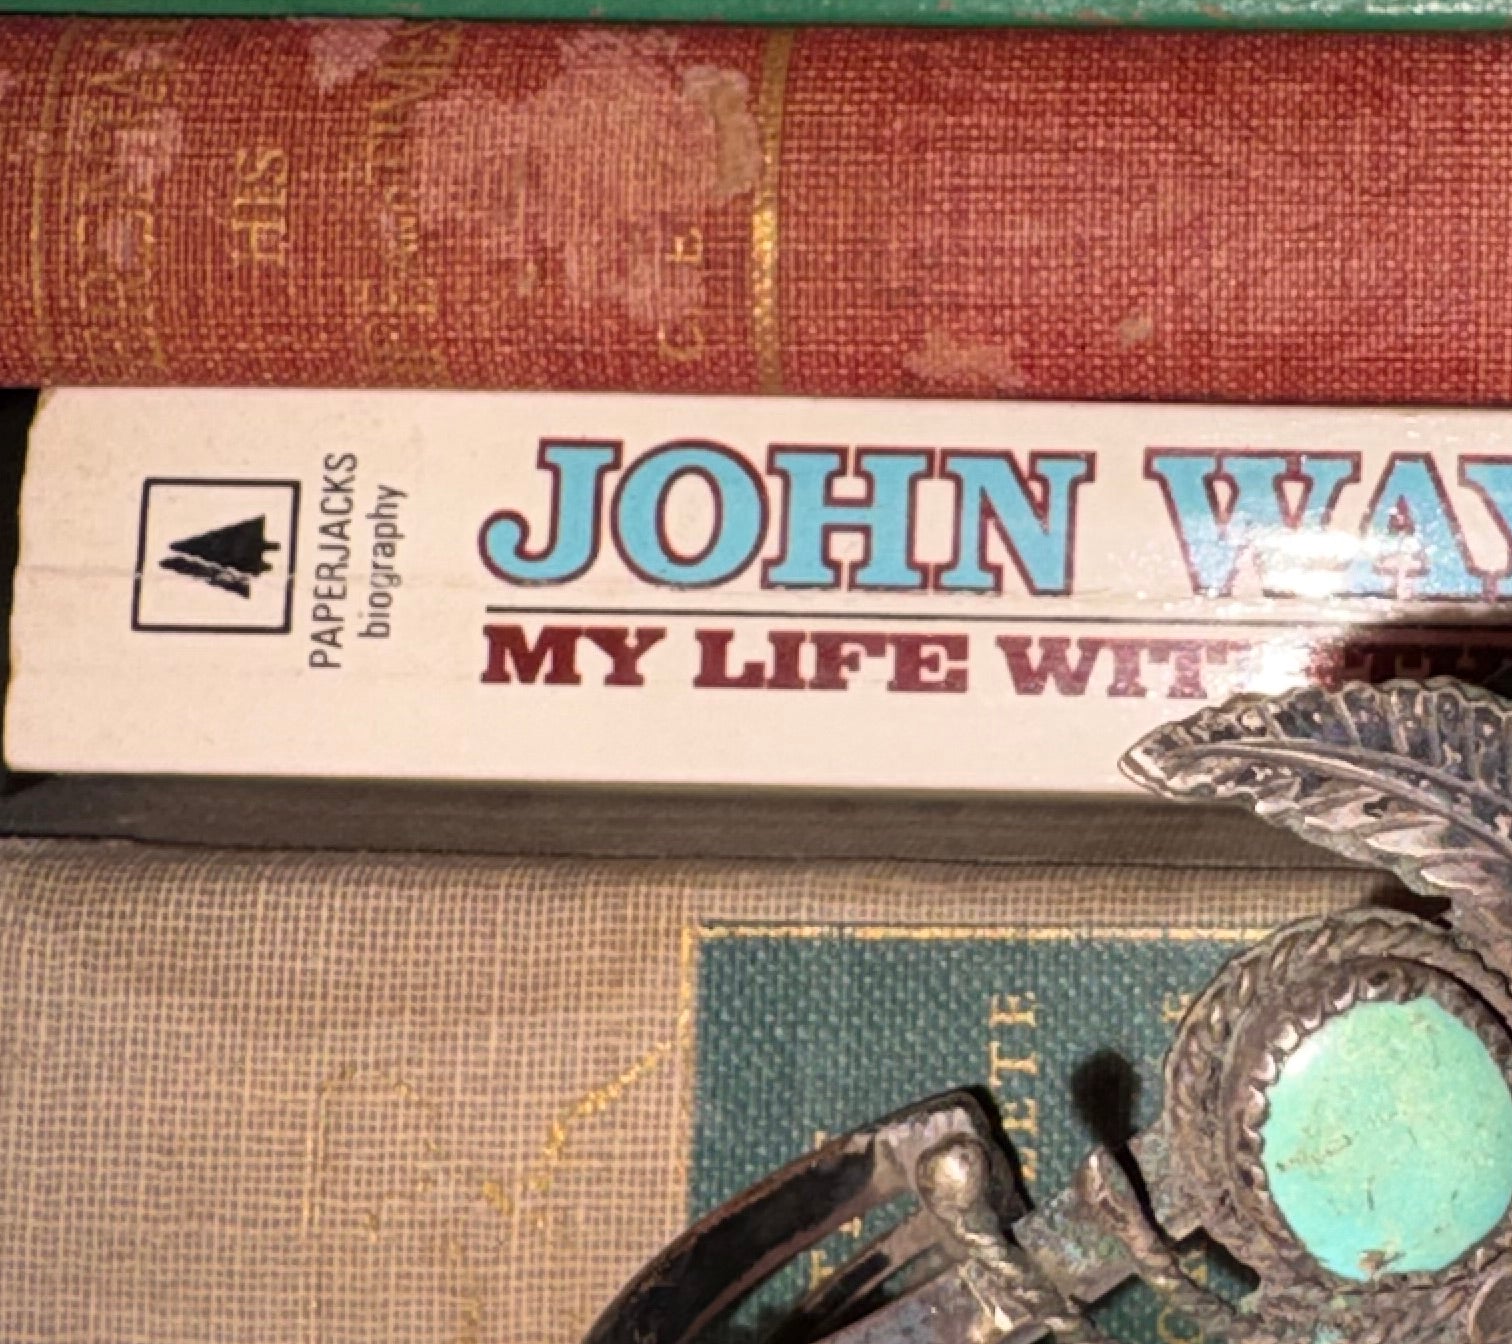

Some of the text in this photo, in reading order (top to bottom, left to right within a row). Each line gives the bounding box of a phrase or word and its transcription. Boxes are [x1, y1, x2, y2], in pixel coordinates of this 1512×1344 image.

[232, 145, 288, 268] HIS
[308, 451, 359, 671] PAPERJACKS
[357, 483, 410, 640] biography
[477, 436, 1098, 597] JOHN
[480, 623, 668, 686] MY
[692, 628, 971, 692] LIFE
